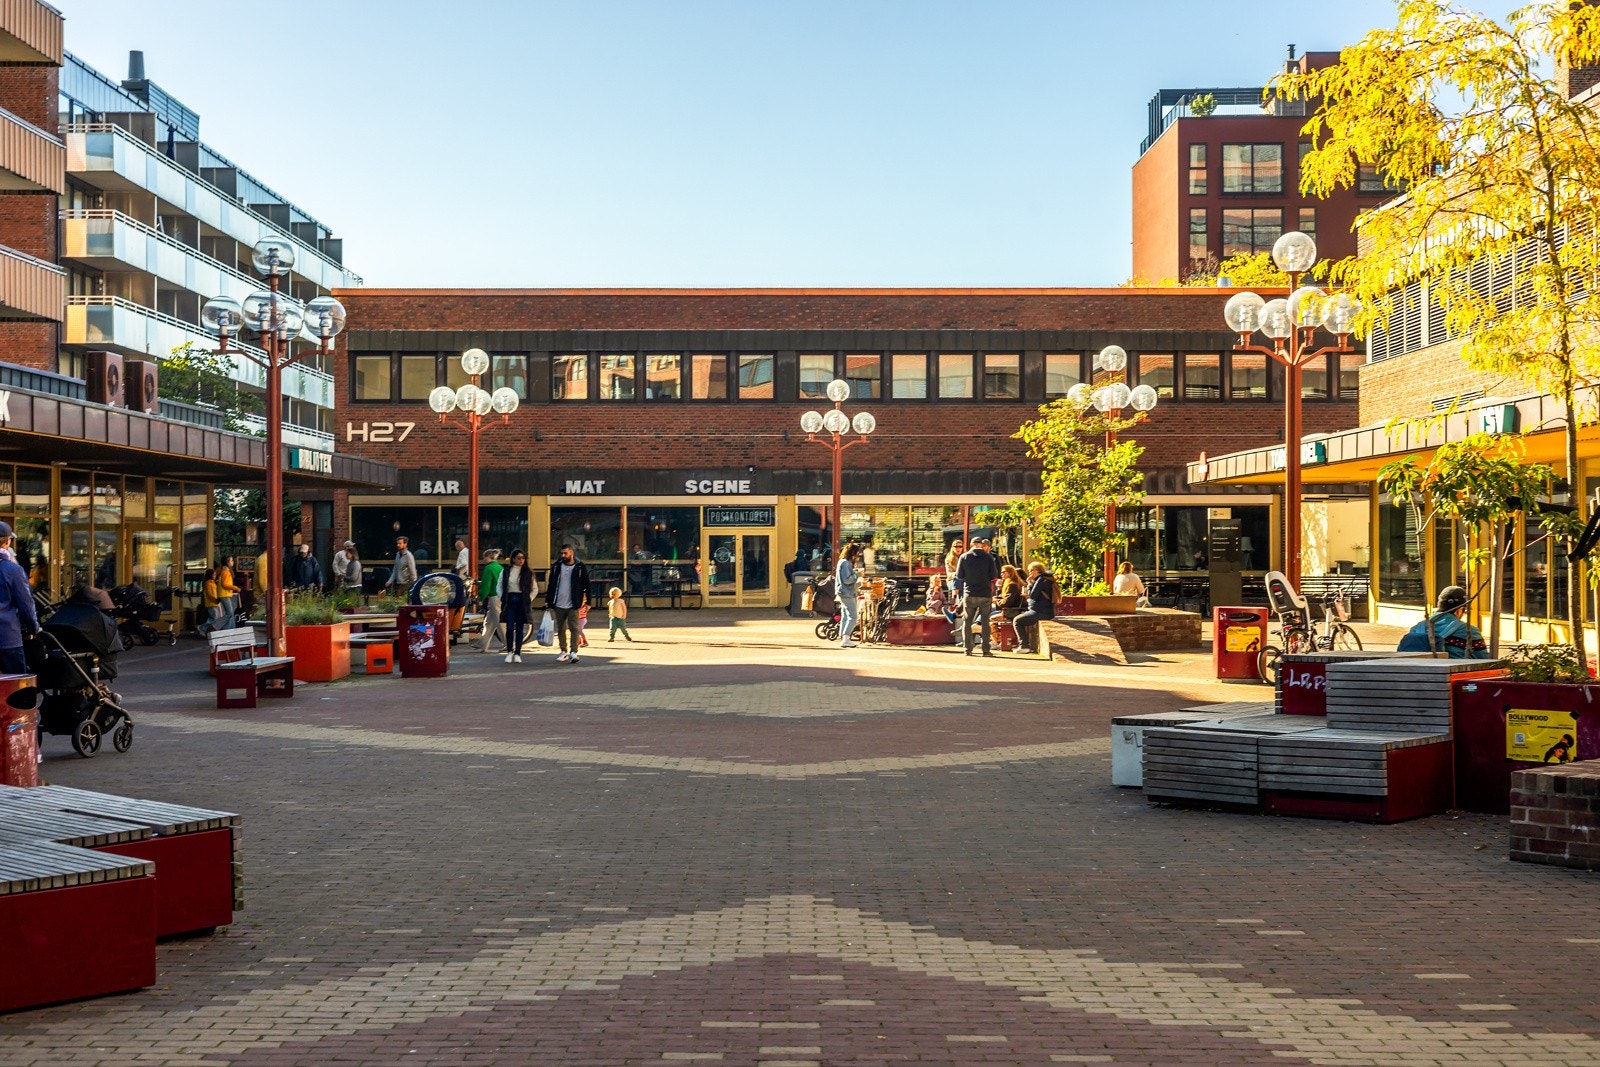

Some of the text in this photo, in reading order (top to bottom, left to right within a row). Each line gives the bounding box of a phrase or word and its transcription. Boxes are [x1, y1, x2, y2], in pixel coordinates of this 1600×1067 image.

[346, 422, 416, 442] H27
[419, 480, 460, 494] BAR
[565, 480, 605, 494] MAT
[685, 479, 751, 494] SCENE
[710, 511, 769, 522] POSTKONTORET
[1508, 714, 1549, 722] BOLLYWOOD
